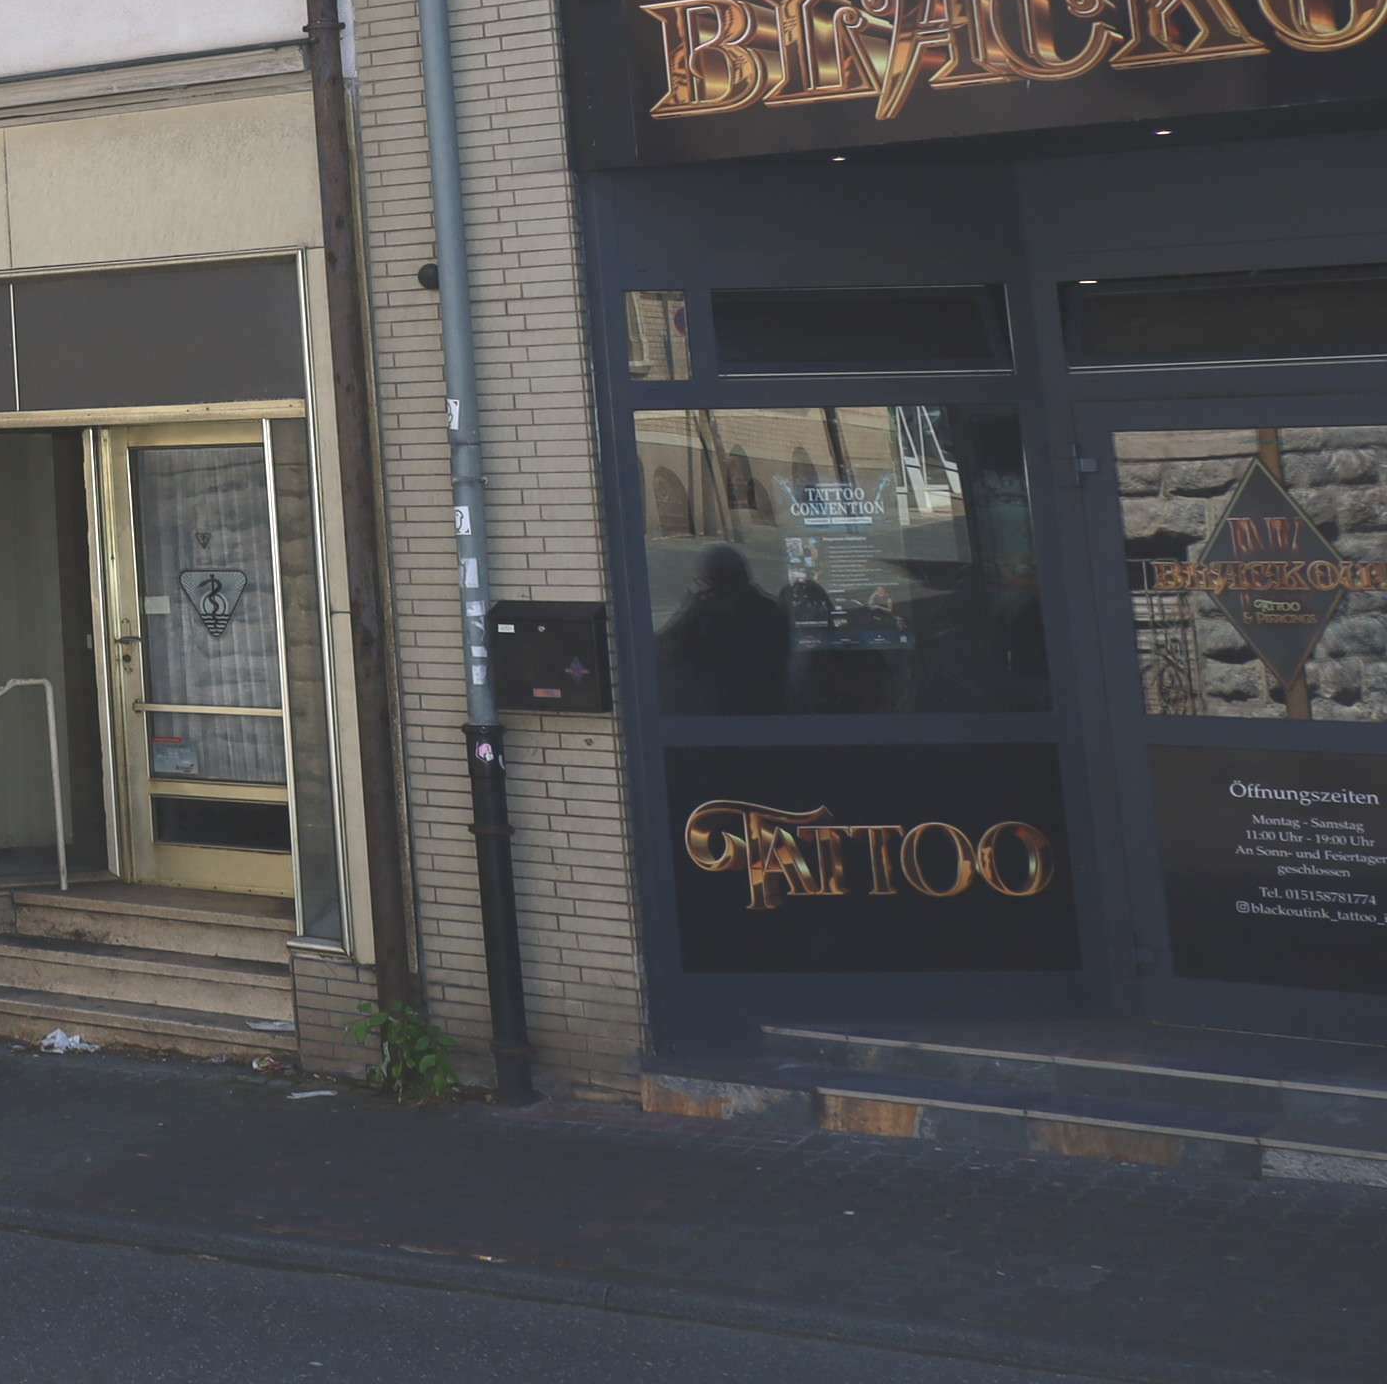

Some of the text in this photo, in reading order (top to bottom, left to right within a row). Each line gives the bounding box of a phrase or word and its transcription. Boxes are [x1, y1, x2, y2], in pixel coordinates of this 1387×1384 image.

[804, 487, 865, 502] TATTOO
[790, 501, 885, 516] CONVENTION
[1229, 780, 1380, 806] Öffnungszeiten
[1251, 814, 1301, 830] Montag
[1310, 817, 1365, 833] Samstag
[1245, 829, 1276, 841] 11:00
[1278, 831, 1304, 843] Uhr
[1315, 833, 1347, 846] 19:00
[1350, 836, 1376, 847] Uhr
[684, 799, 1055, 910] TATTOO
[1235, 845, 1254, 856] An
[1256, 846, 1292, 858] Sonn-
[1295, 848, 1321, 860] und
[1277, 864, 1351, 878] geschlossen
[1259, 886, 1377, 905] Tel. 015158781774
